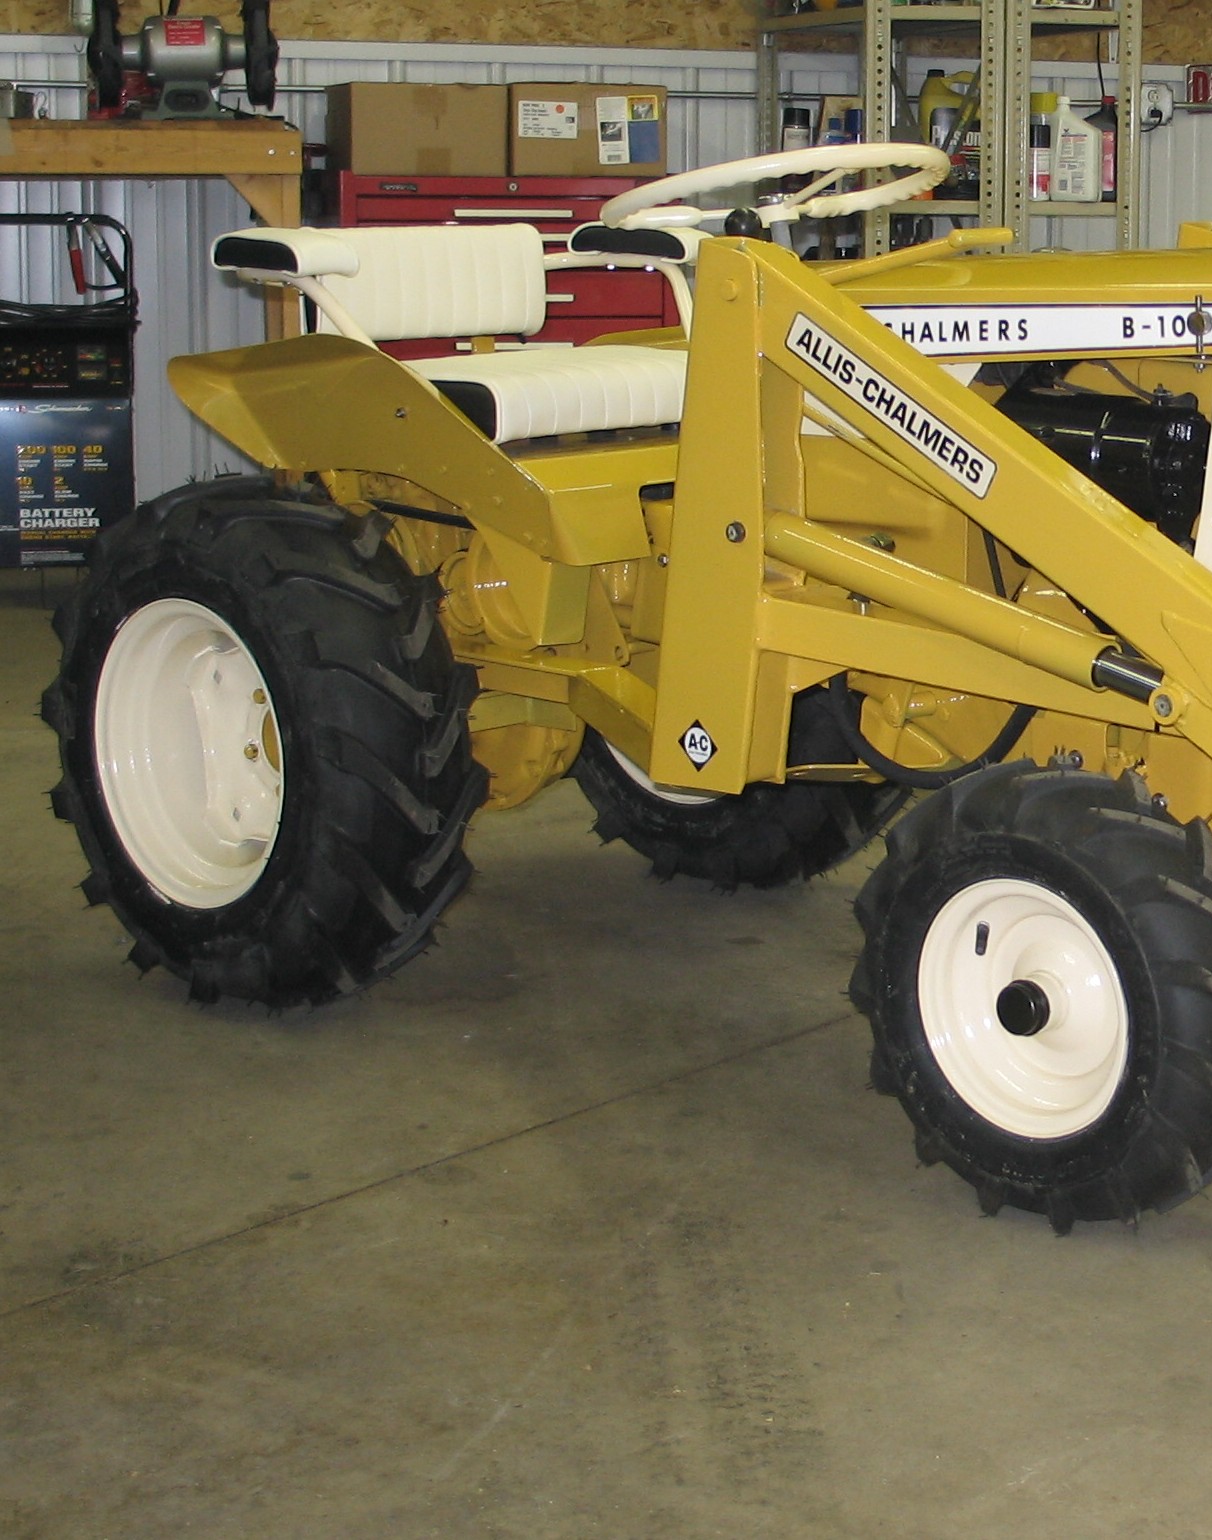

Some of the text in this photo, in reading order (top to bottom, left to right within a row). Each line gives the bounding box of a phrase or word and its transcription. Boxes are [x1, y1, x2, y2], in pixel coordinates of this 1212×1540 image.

[884, 319, 1029, 343] HALMERS
[796, 328, 984, 484] ALLIS-CHALMERS
[20, 507, 96, 518] BATTERY
[20, 518, 100, 528] CHARGER
